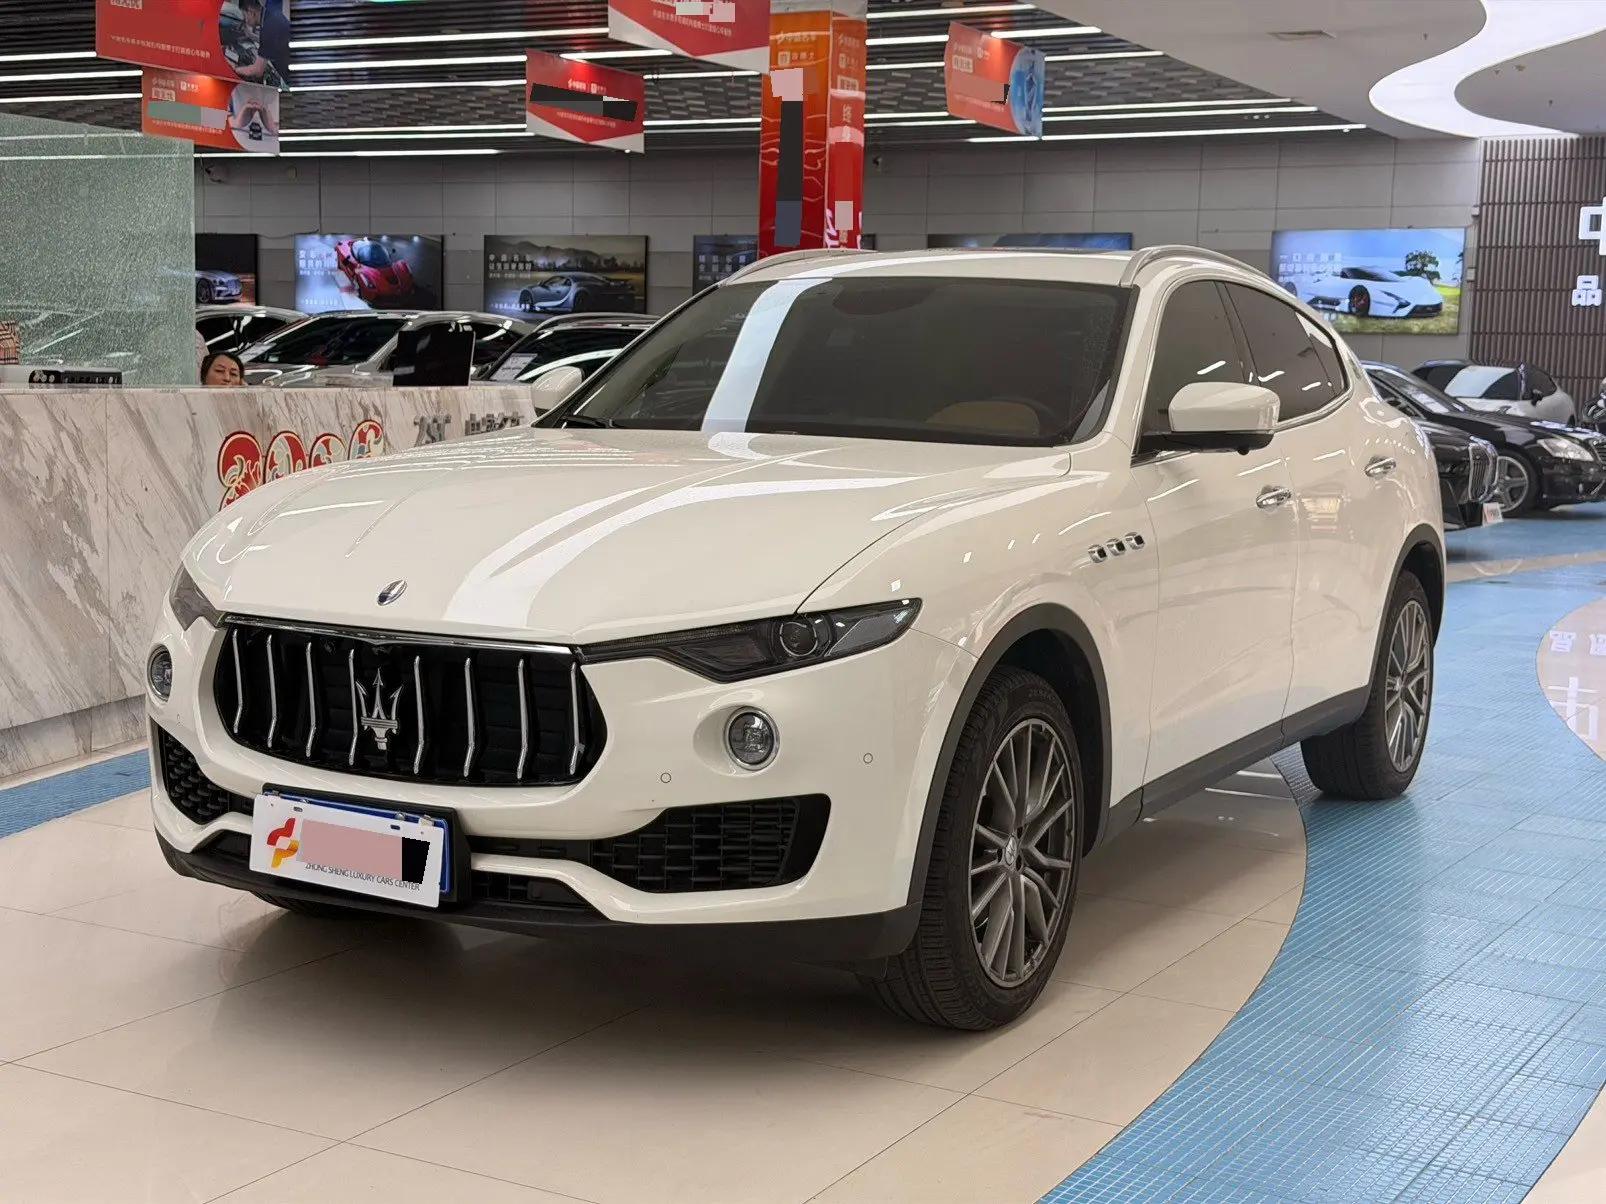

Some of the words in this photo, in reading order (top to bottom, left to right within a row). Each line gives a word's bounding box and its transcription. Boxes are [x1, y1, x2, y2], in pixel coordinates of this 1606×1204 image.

[328, 867, 349, 877] SHENG
[350, 870, 375, 882] LUXURY
[376, 876, 393, 886] CARS
[394, 880, 420, 891] CENTER
